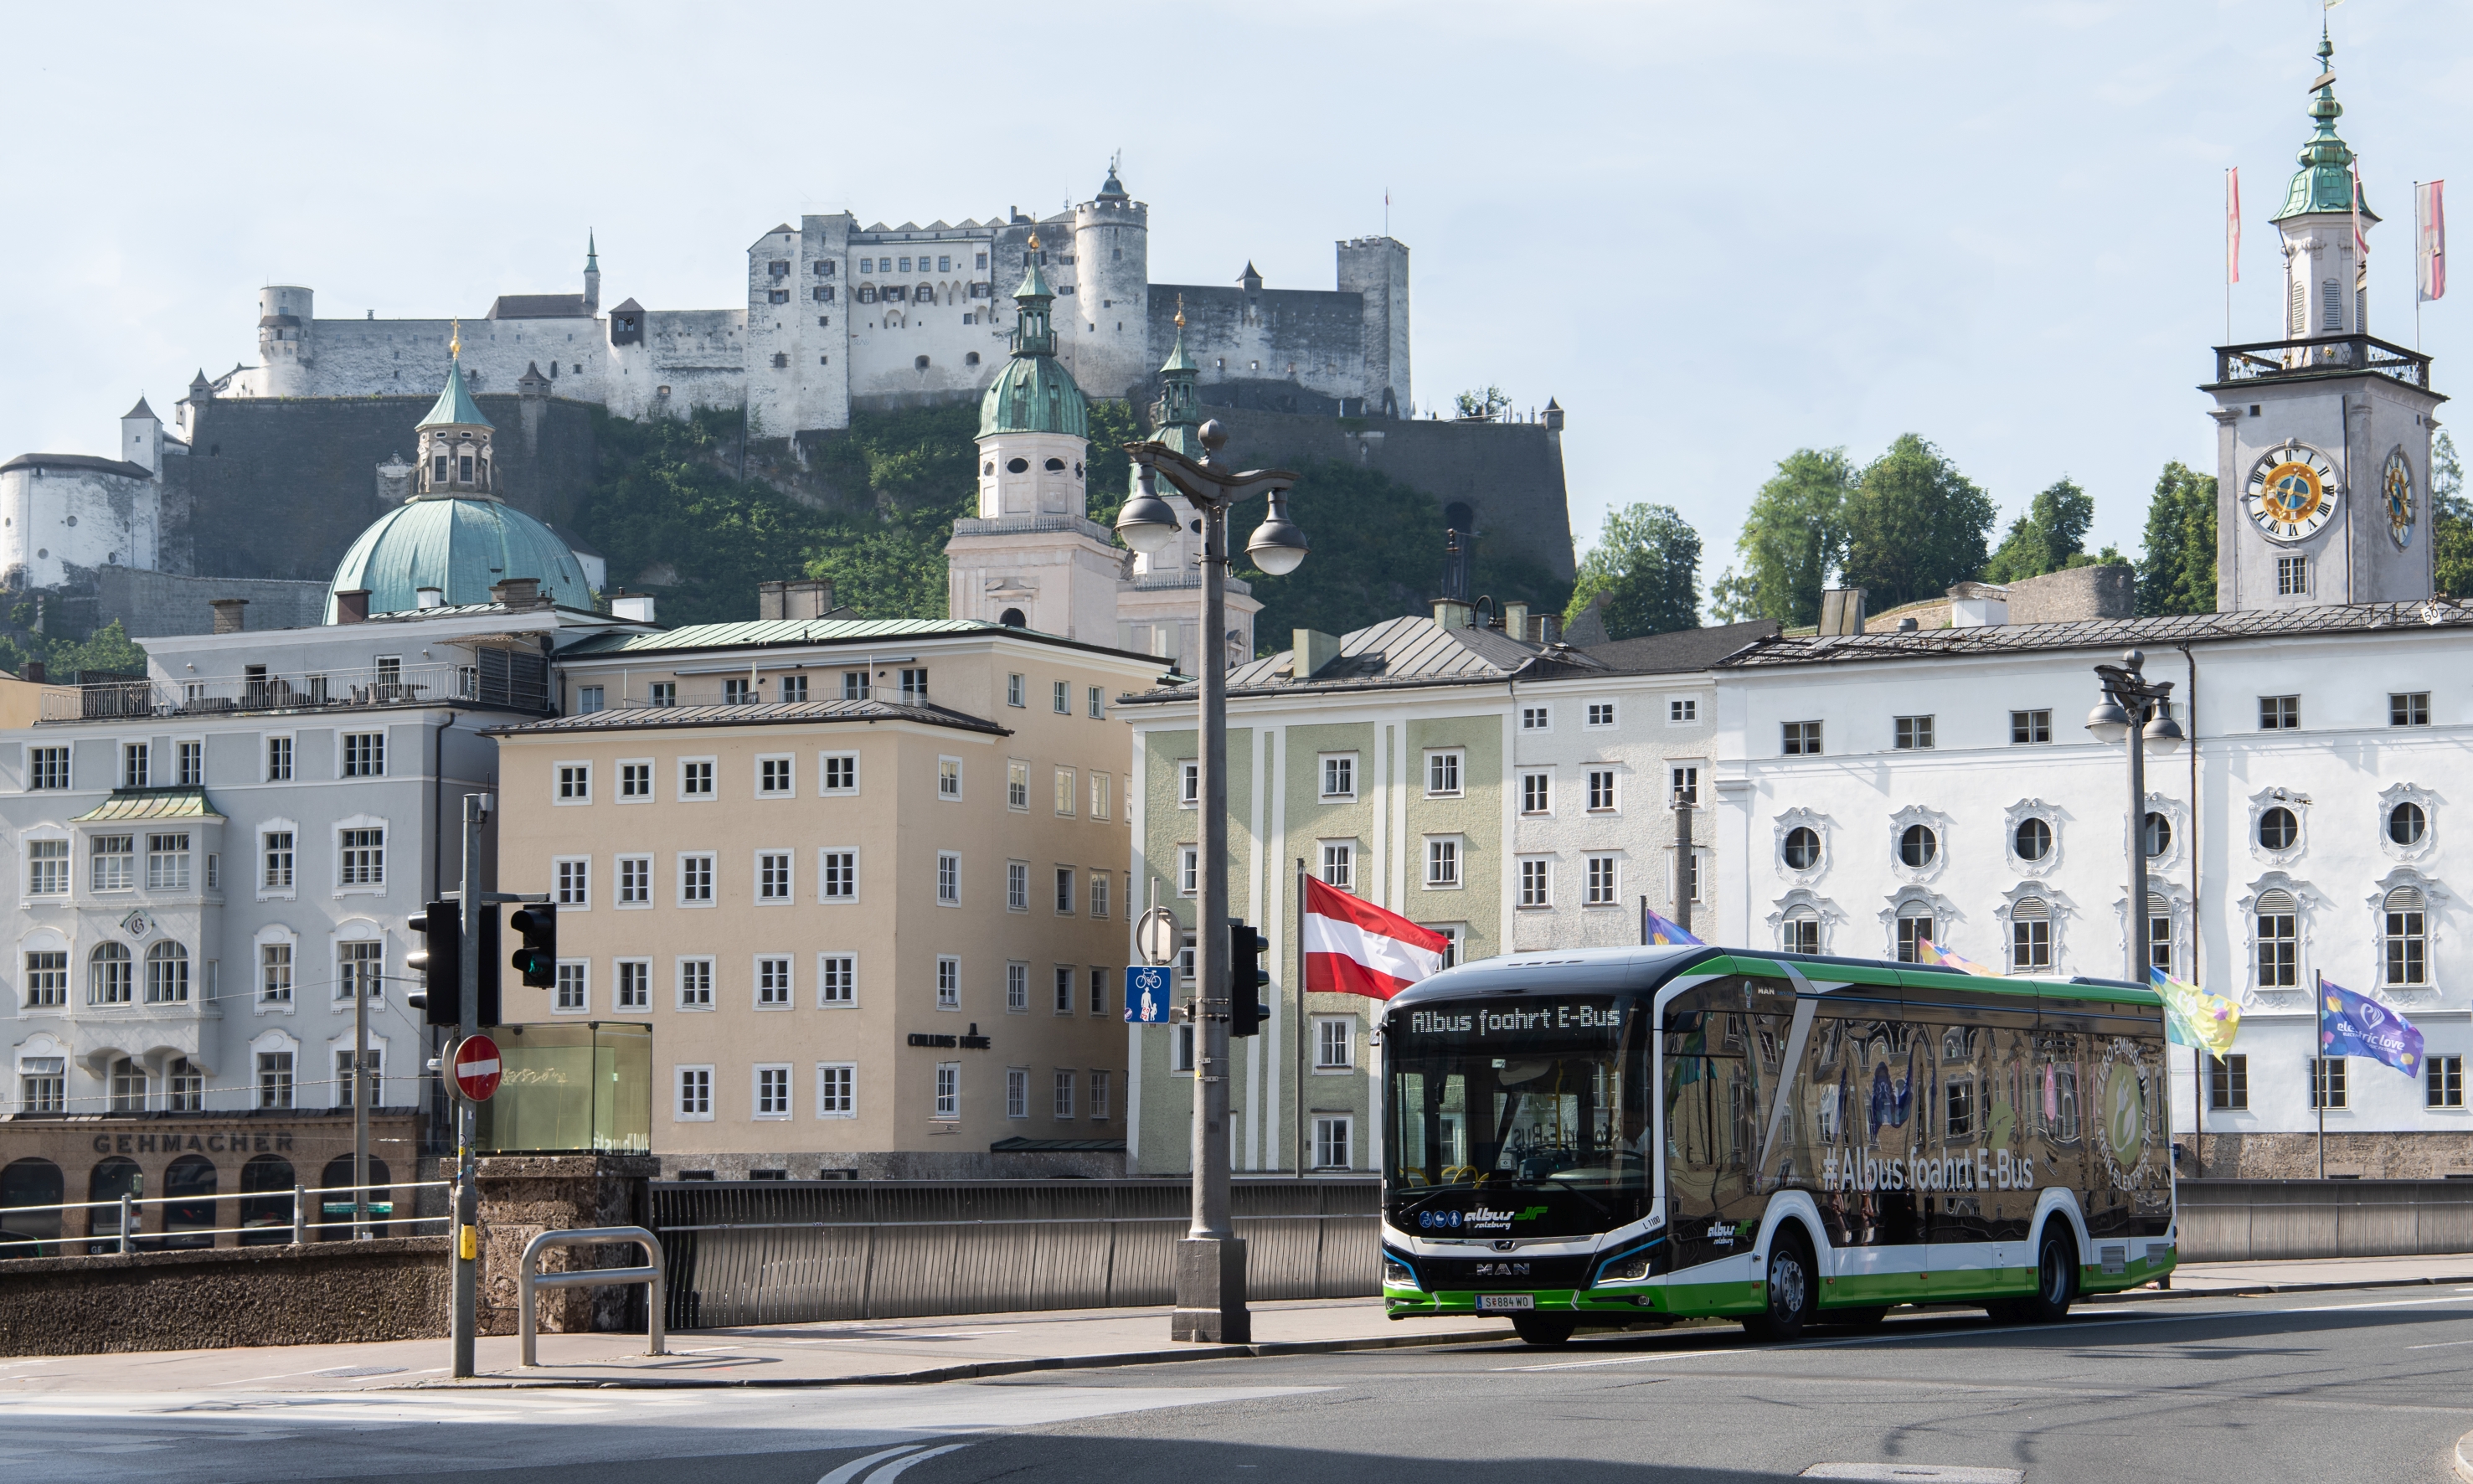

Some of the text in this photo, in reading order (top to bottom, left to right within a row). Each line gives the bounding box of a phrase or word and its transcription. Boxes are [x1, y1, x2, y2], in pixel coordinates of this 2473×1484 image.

[2424, 608, 2439, 621] 50
[1758, 987, 1775, 995] MAN
[1412, 1005, 1620, 1036] Albus foahrt E-Bus
[2379, 1033, 2405, 1051] love
[2096, 1037, 2150, 1096] ZERO EMISSION
[93, 1132, 293, 1154] GEHMACHER
[2098, 1128, 2152, 1192] REIN ELEKTRISCH
[1822, 1146, 2034, 1192] #Albus foahrt E-Bus
[1463, 1207, 1515, 1222] albus
[1474, 1221, 1512, 1230] salzburg
[1642, 1215, 1661, 1230] L 1100
[1707, 1221, 1735, 1237] albus
[1713, 1237, 1734, 1246] salzburg
[1476, 1263, 1530, 1275] MAN
